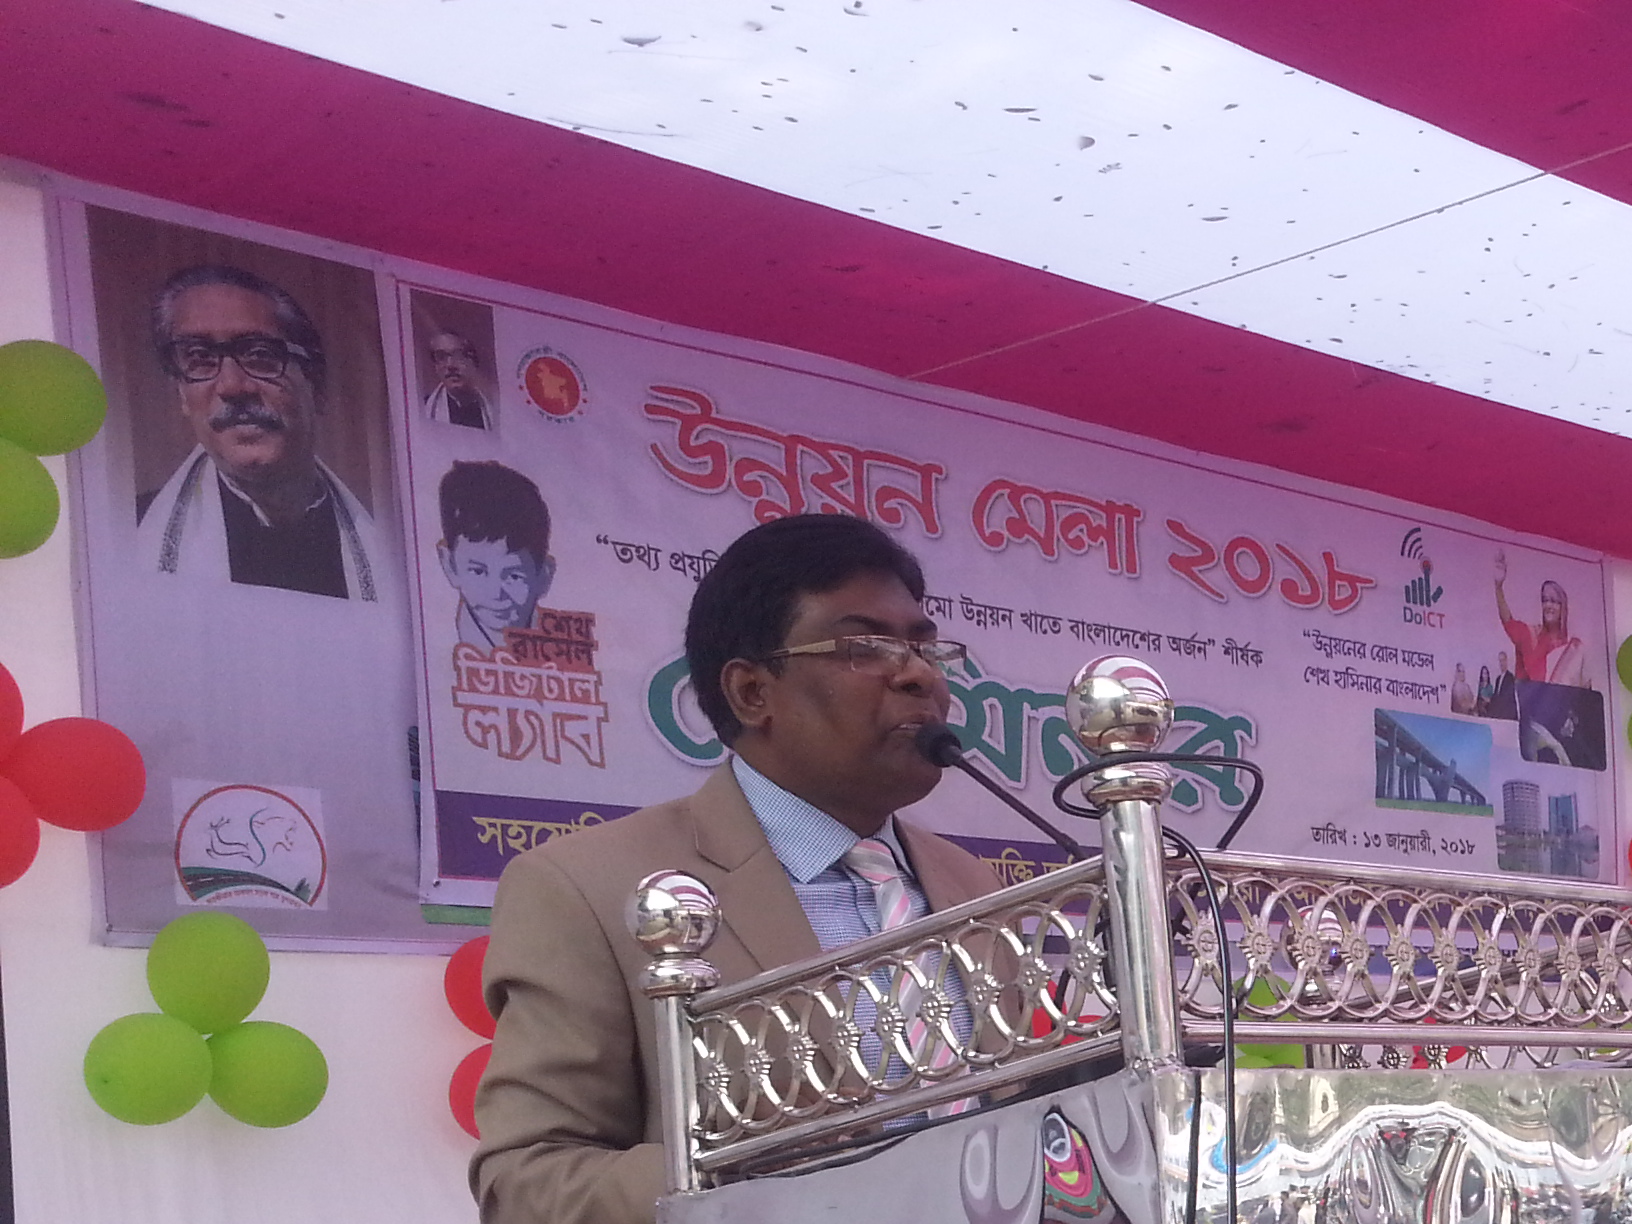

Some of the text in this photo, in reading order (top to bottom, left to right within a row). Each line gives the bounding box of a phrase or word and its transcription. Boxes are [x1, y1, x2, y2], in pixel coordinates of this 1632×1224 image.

[643, 383, 1377, 613] উন্নয়ন মেলা ২০১৮
[541, 612, 595, 638] শেখ
[961, 594, 1014, 630] উন্নয়ন
[1020, 610, 1062, 635] খাতে
[1068, 618, 1162, 655] বাংলাদেশের
[1222, 637, 1264, 668] শীর্ষক
[1403, 606, 1445, 629] DoICT
[507, 631, 595, 666] রাসেল
[1371, 643, 1398, 665] রোল
[1401, 649, 1434, 671] মডেল
[456, 646, 599, 704] ডিজিটাল
[1304, 665, 1330, 686] শেখ
[1333, 667, 1382, 695] হাসিনার
[1311, 822, 1347, 846] তারিখ
[1363, 831, 1382, 848] ১৩
[1440, 837, 1476, 855] ২০১৮
